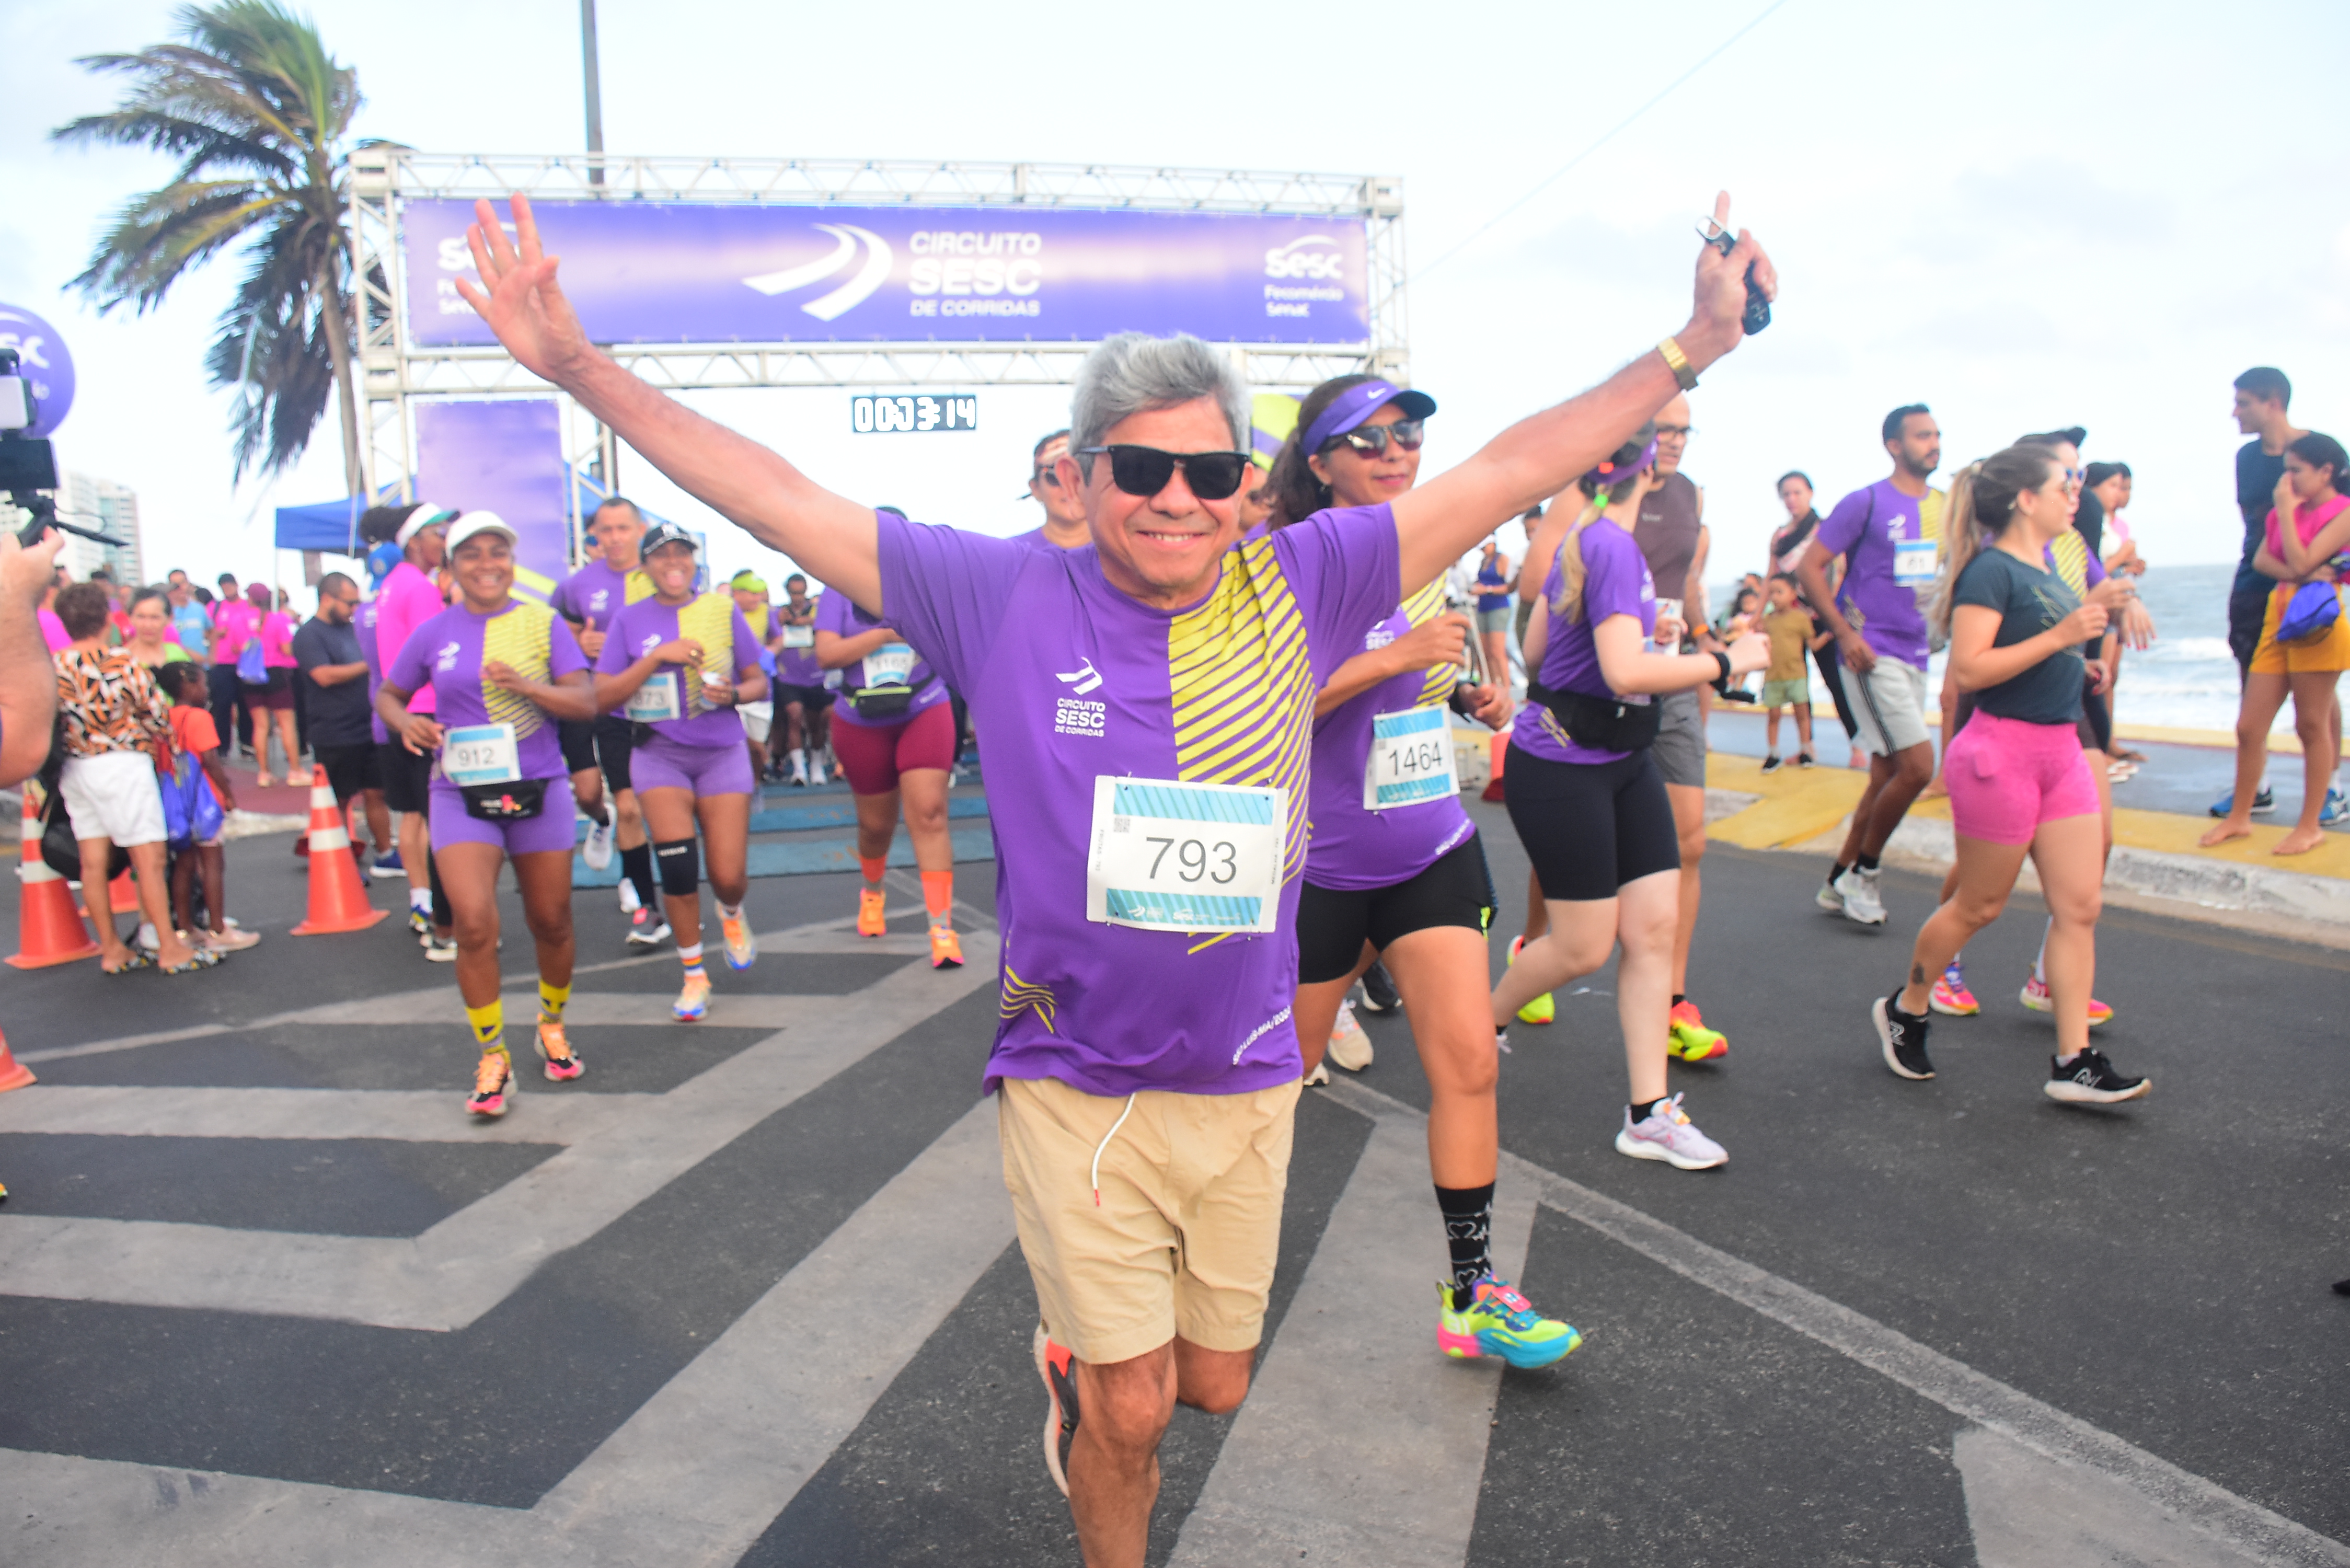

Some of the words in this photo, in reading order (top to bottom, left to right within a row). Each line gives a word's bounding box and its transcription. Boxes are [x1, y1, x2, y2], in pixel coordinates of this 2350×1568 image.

[910, 231, 1042, 256] CIRCUITO
[909, 258, 1042, 295] SESC
[910, 299, 939, 316] DE
[941, 299, 1041, 317] CORRIDAS
[1057, 698, 1106, 712] CIRCUITO
[1055, 709, 1105, 728] SESC
[458, 746, 494, 767] 912
[1389, 741, 1442, 777] 1464
[1146, 837, 1237, 884] 793
